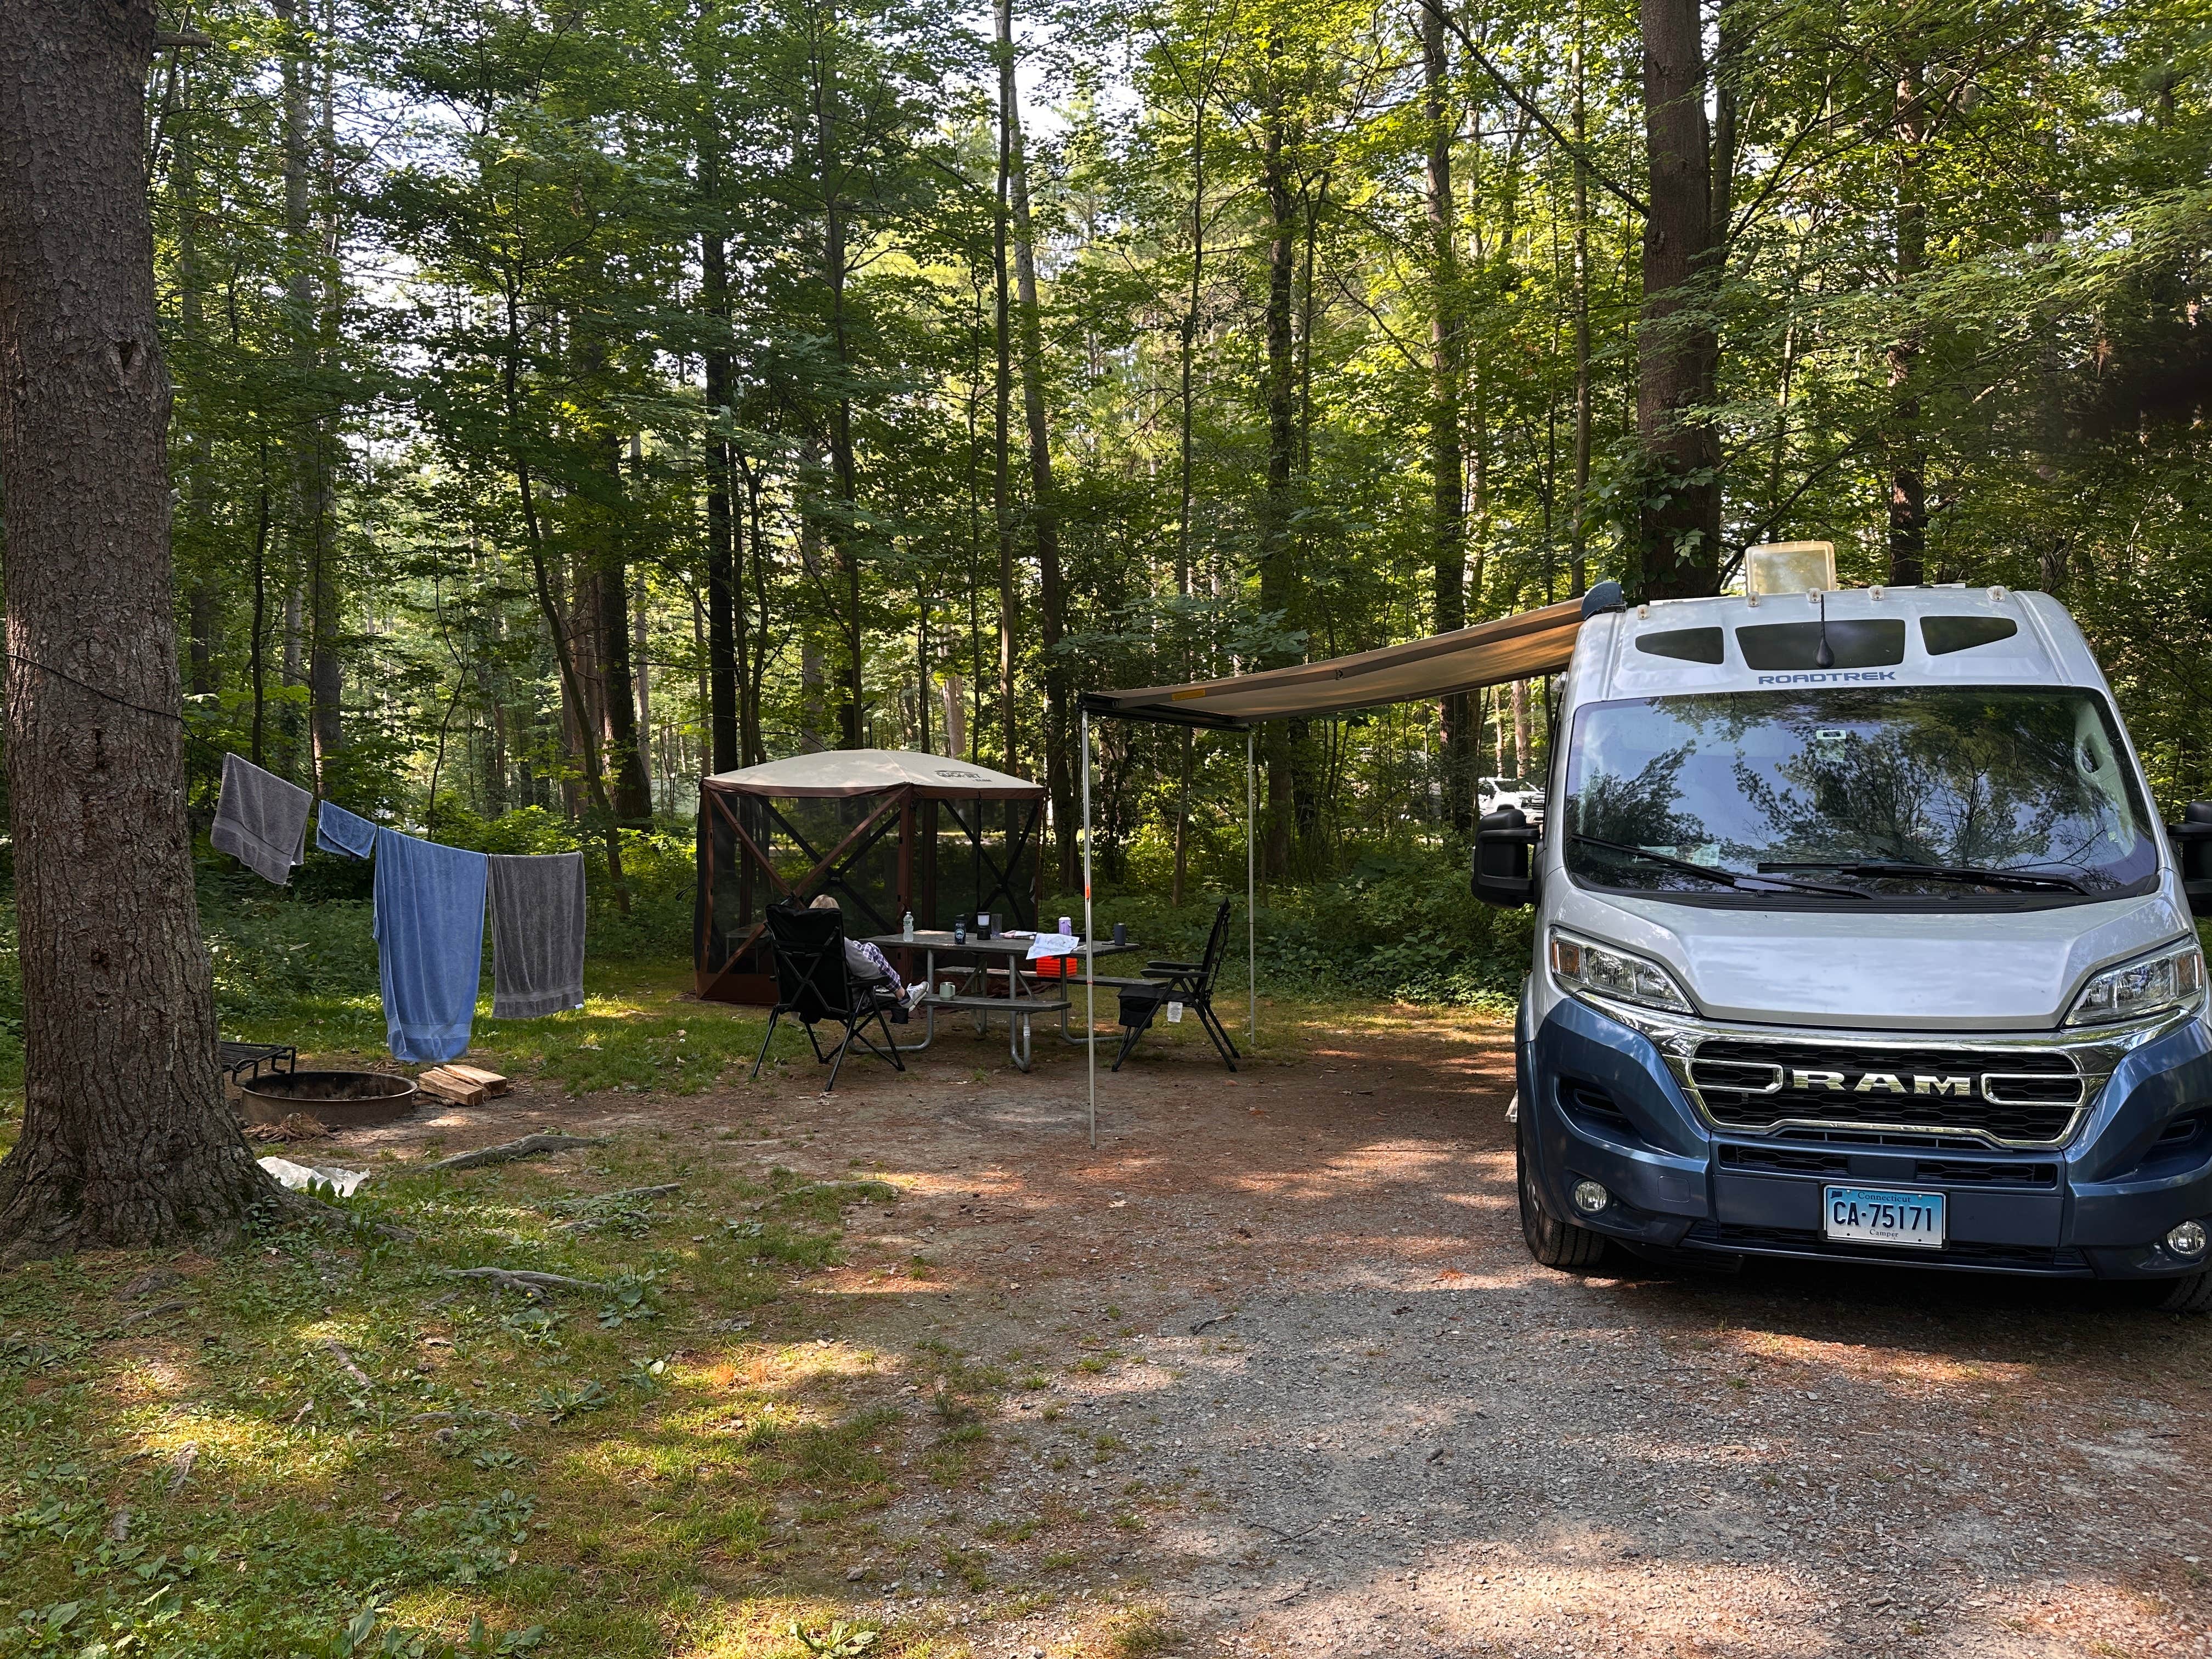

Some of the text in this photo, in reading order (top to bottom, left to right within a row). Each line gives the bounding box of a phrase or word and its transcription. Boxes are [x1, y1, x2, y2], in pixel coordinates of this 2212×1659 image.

[1758, 671, 1896, 685] ROADTREK
[1791, 1069, 1972, 1096] RAM
[1858, 1192, 1911, 1203] Connecticut
[1869, 1229, 1899, 1238] Camper
